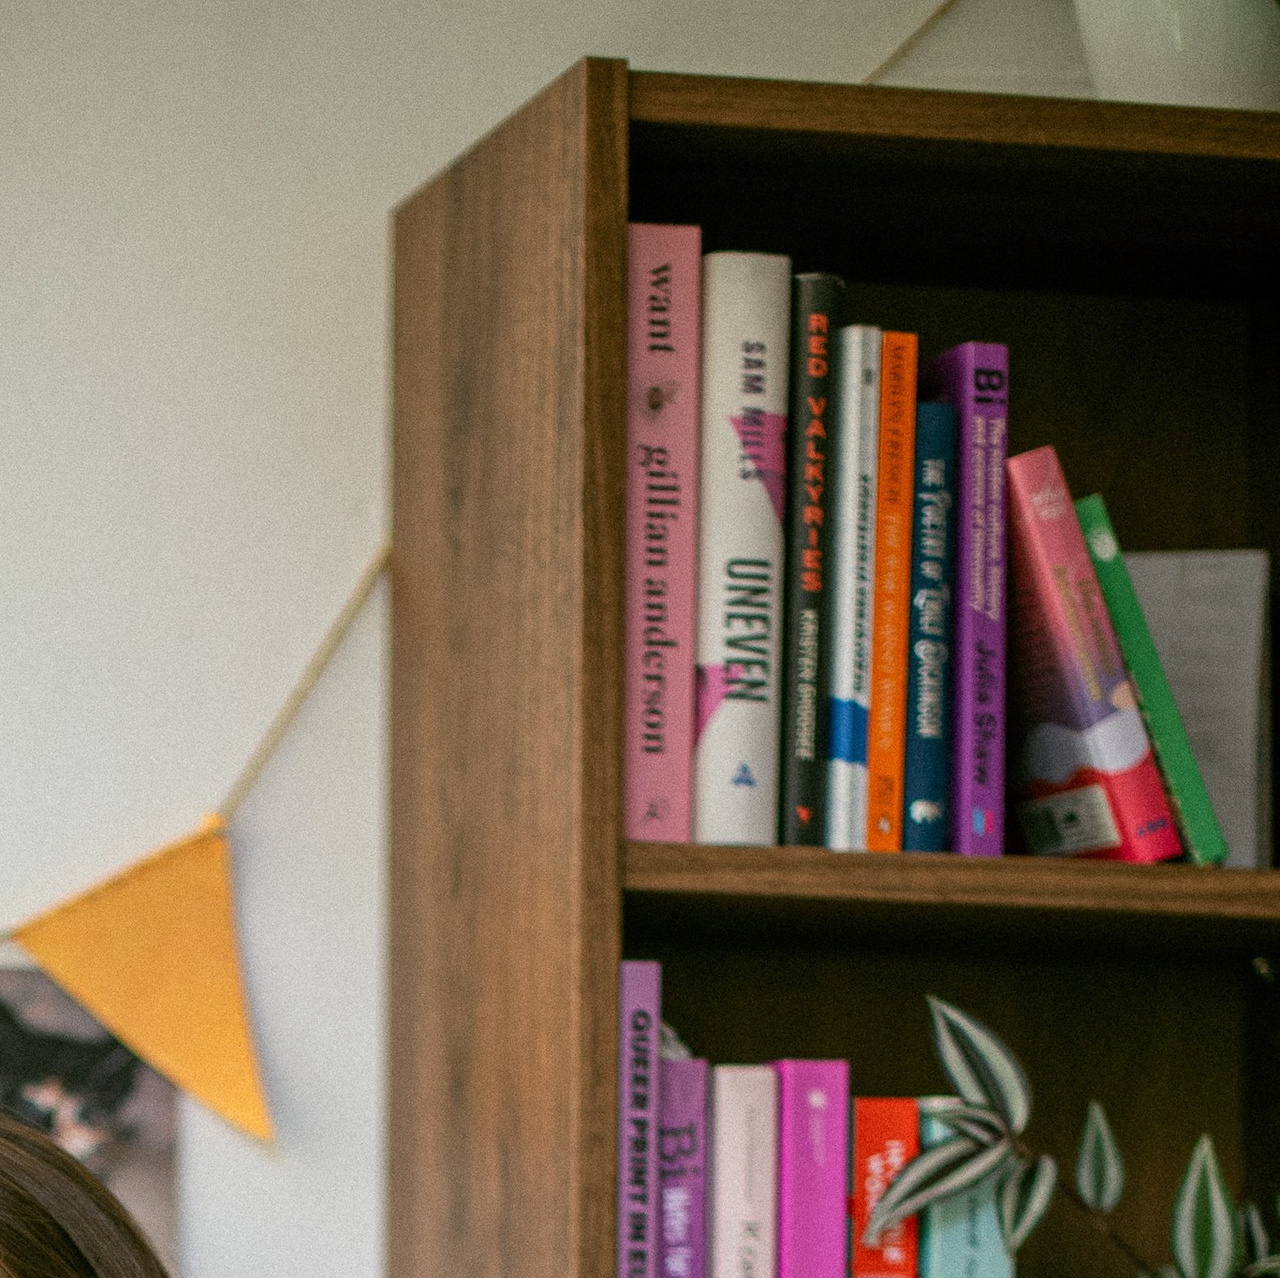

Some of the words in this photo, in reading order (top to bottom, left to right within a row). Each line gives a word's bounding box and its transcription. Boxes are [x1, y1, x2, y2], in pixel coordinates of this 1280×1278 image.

[649, 263, 675, 354] want
[743, 342, 766, 395] SAM
[808, 315, 828, 377] RED
[974, 369, 1005, 404] Bi
[740, 408, 765, 481] MILLS
[637, 445, 681, 567] gillian
[803, 398, 826, 592] VALKYRIES
[644, 578, 677, 754] anderson
[724, 558, 770, 703] UNEVEN
[976, 641, 997, 702] Julia
[974, 714, 998, 785] Shaw
[630, 1009, 652, 1112] QUEER
[629, 1116, 650, 1206] PRINT
[658, 1123, 701, 1180] Bi
[628, 1211, 648, 1243] IN
